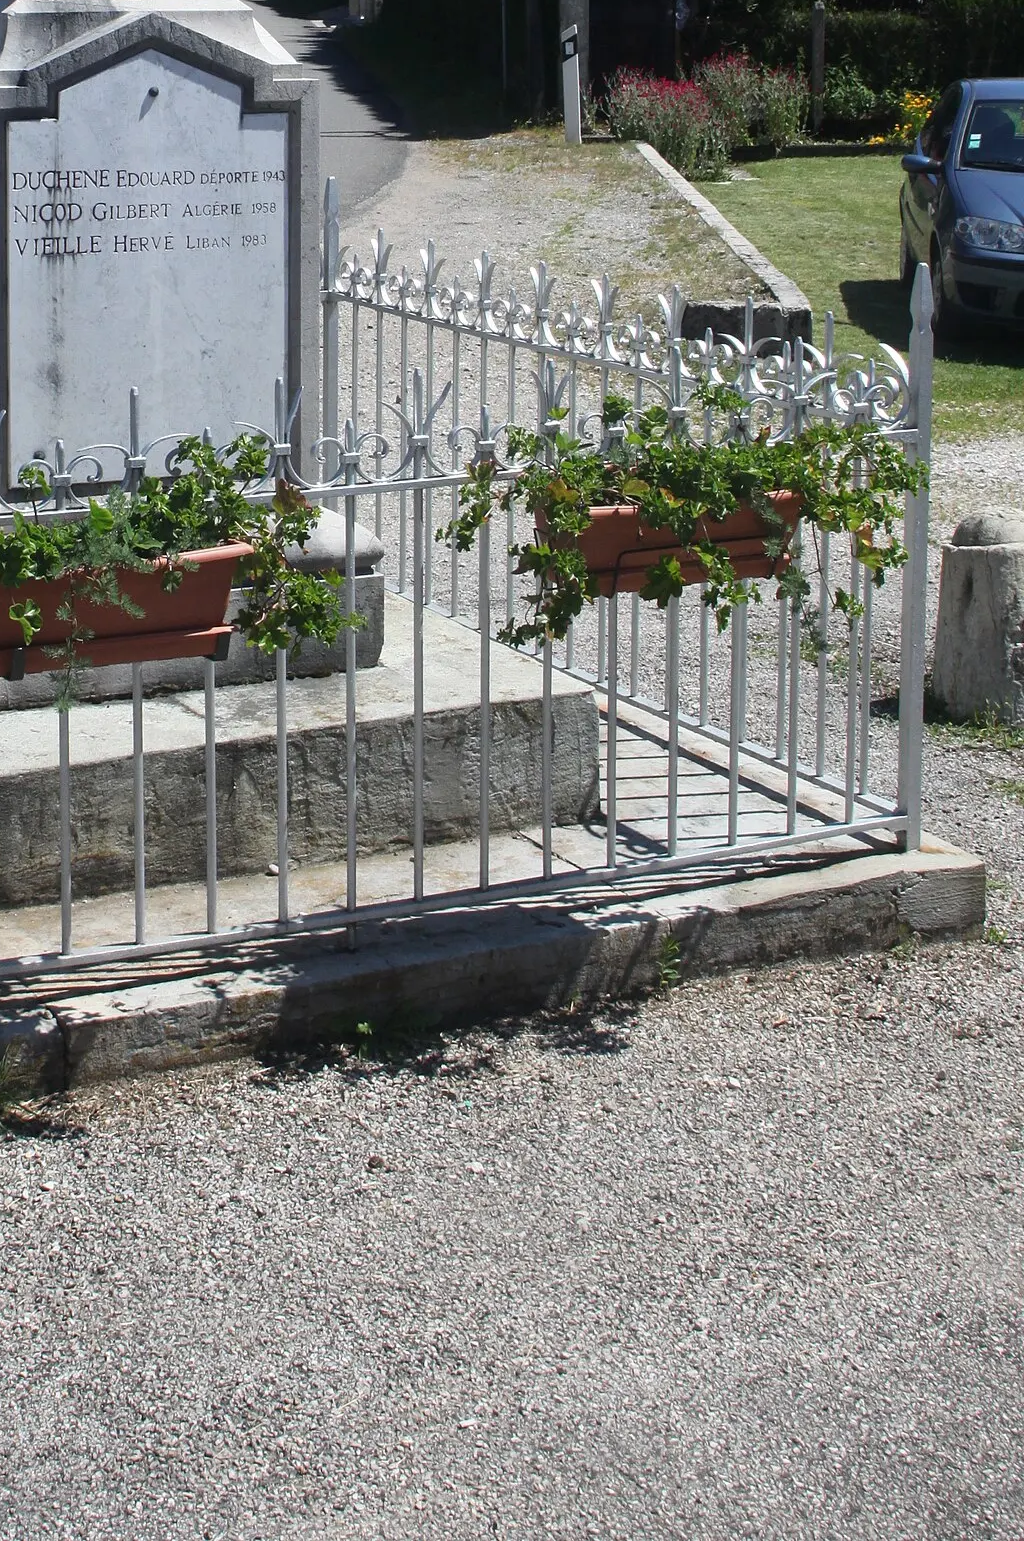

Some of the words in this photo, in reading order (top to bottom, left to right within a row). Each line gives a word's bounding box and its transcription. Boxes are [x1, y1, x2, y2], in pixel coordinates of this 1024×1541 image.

[12, 169, 110, 190] DUCHENE
[116, 169, 195, 188] EDOUARD
[262, 170, 286, 182] 1943
[14, 202, 83, 223] NICOD
[92, 202, 172, 221] GILBERT
[182, 201, 242, 218] ALGÉRIE
[251, 202, 277, 214] 1958
[15, 235, 102, 257] VIEILLE
[113, 232, 174, 254] HERVÉ
[186, 235, 231, 250] LIBAN
[241, 234, 267, 248] 1983
